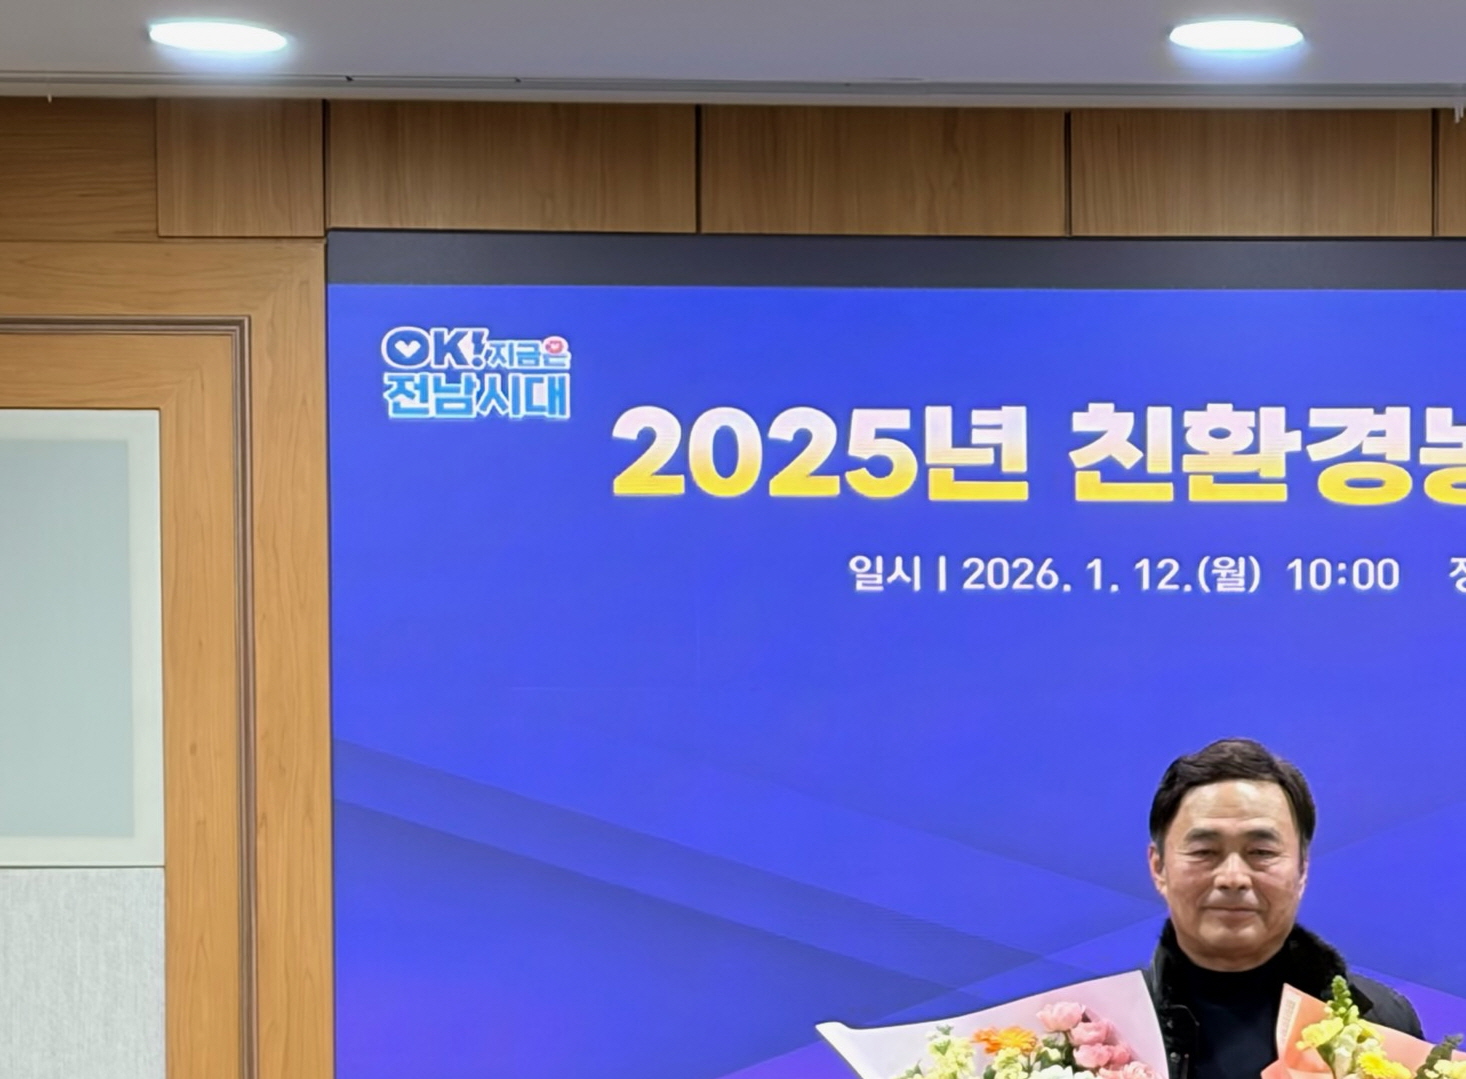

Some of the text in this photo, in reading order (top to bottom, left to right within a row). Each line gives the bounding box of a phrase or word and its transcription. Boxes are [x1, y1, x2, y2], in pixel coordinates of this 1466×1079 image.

[381, 326, 572, 369] OK! 지금은
[383, 372, 570, 419] 전남시대
[612, 404, 1029, 503] 2025년
[848, 555, 921, 593] 일시
[962, 557, 1072, 593] 2026.
[1086, 557, 1119, 593] 1.
[1287, 557, 1400, 592] 10:00
